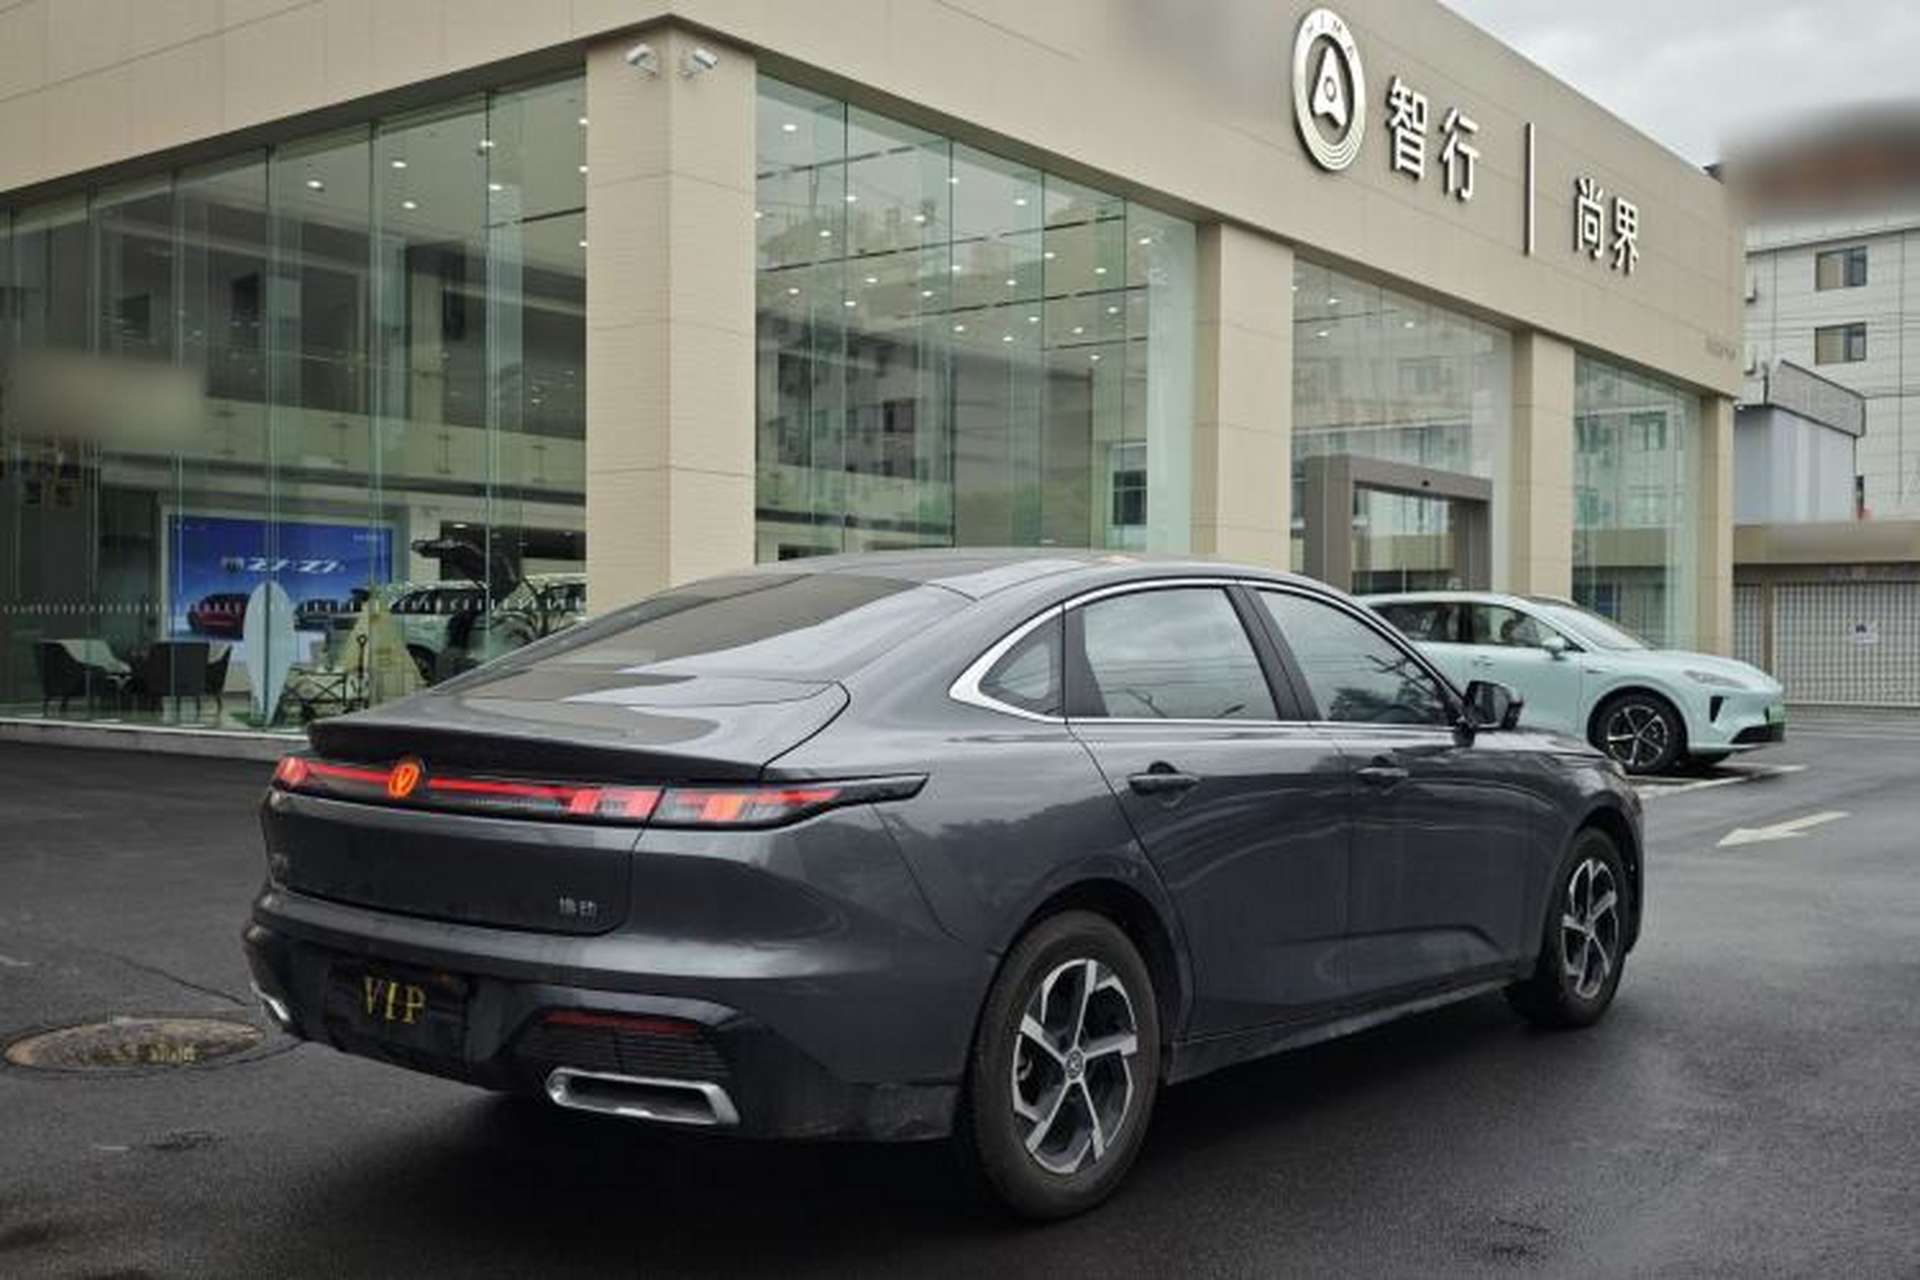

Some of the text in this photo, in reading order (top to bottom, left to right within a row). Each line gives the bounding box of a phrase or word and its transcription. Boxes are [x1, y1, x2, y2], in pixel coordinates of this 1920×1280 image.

[1388, 77, 1639, 272] 智行 尚界
[364, 976, 426, 1023] VIP
